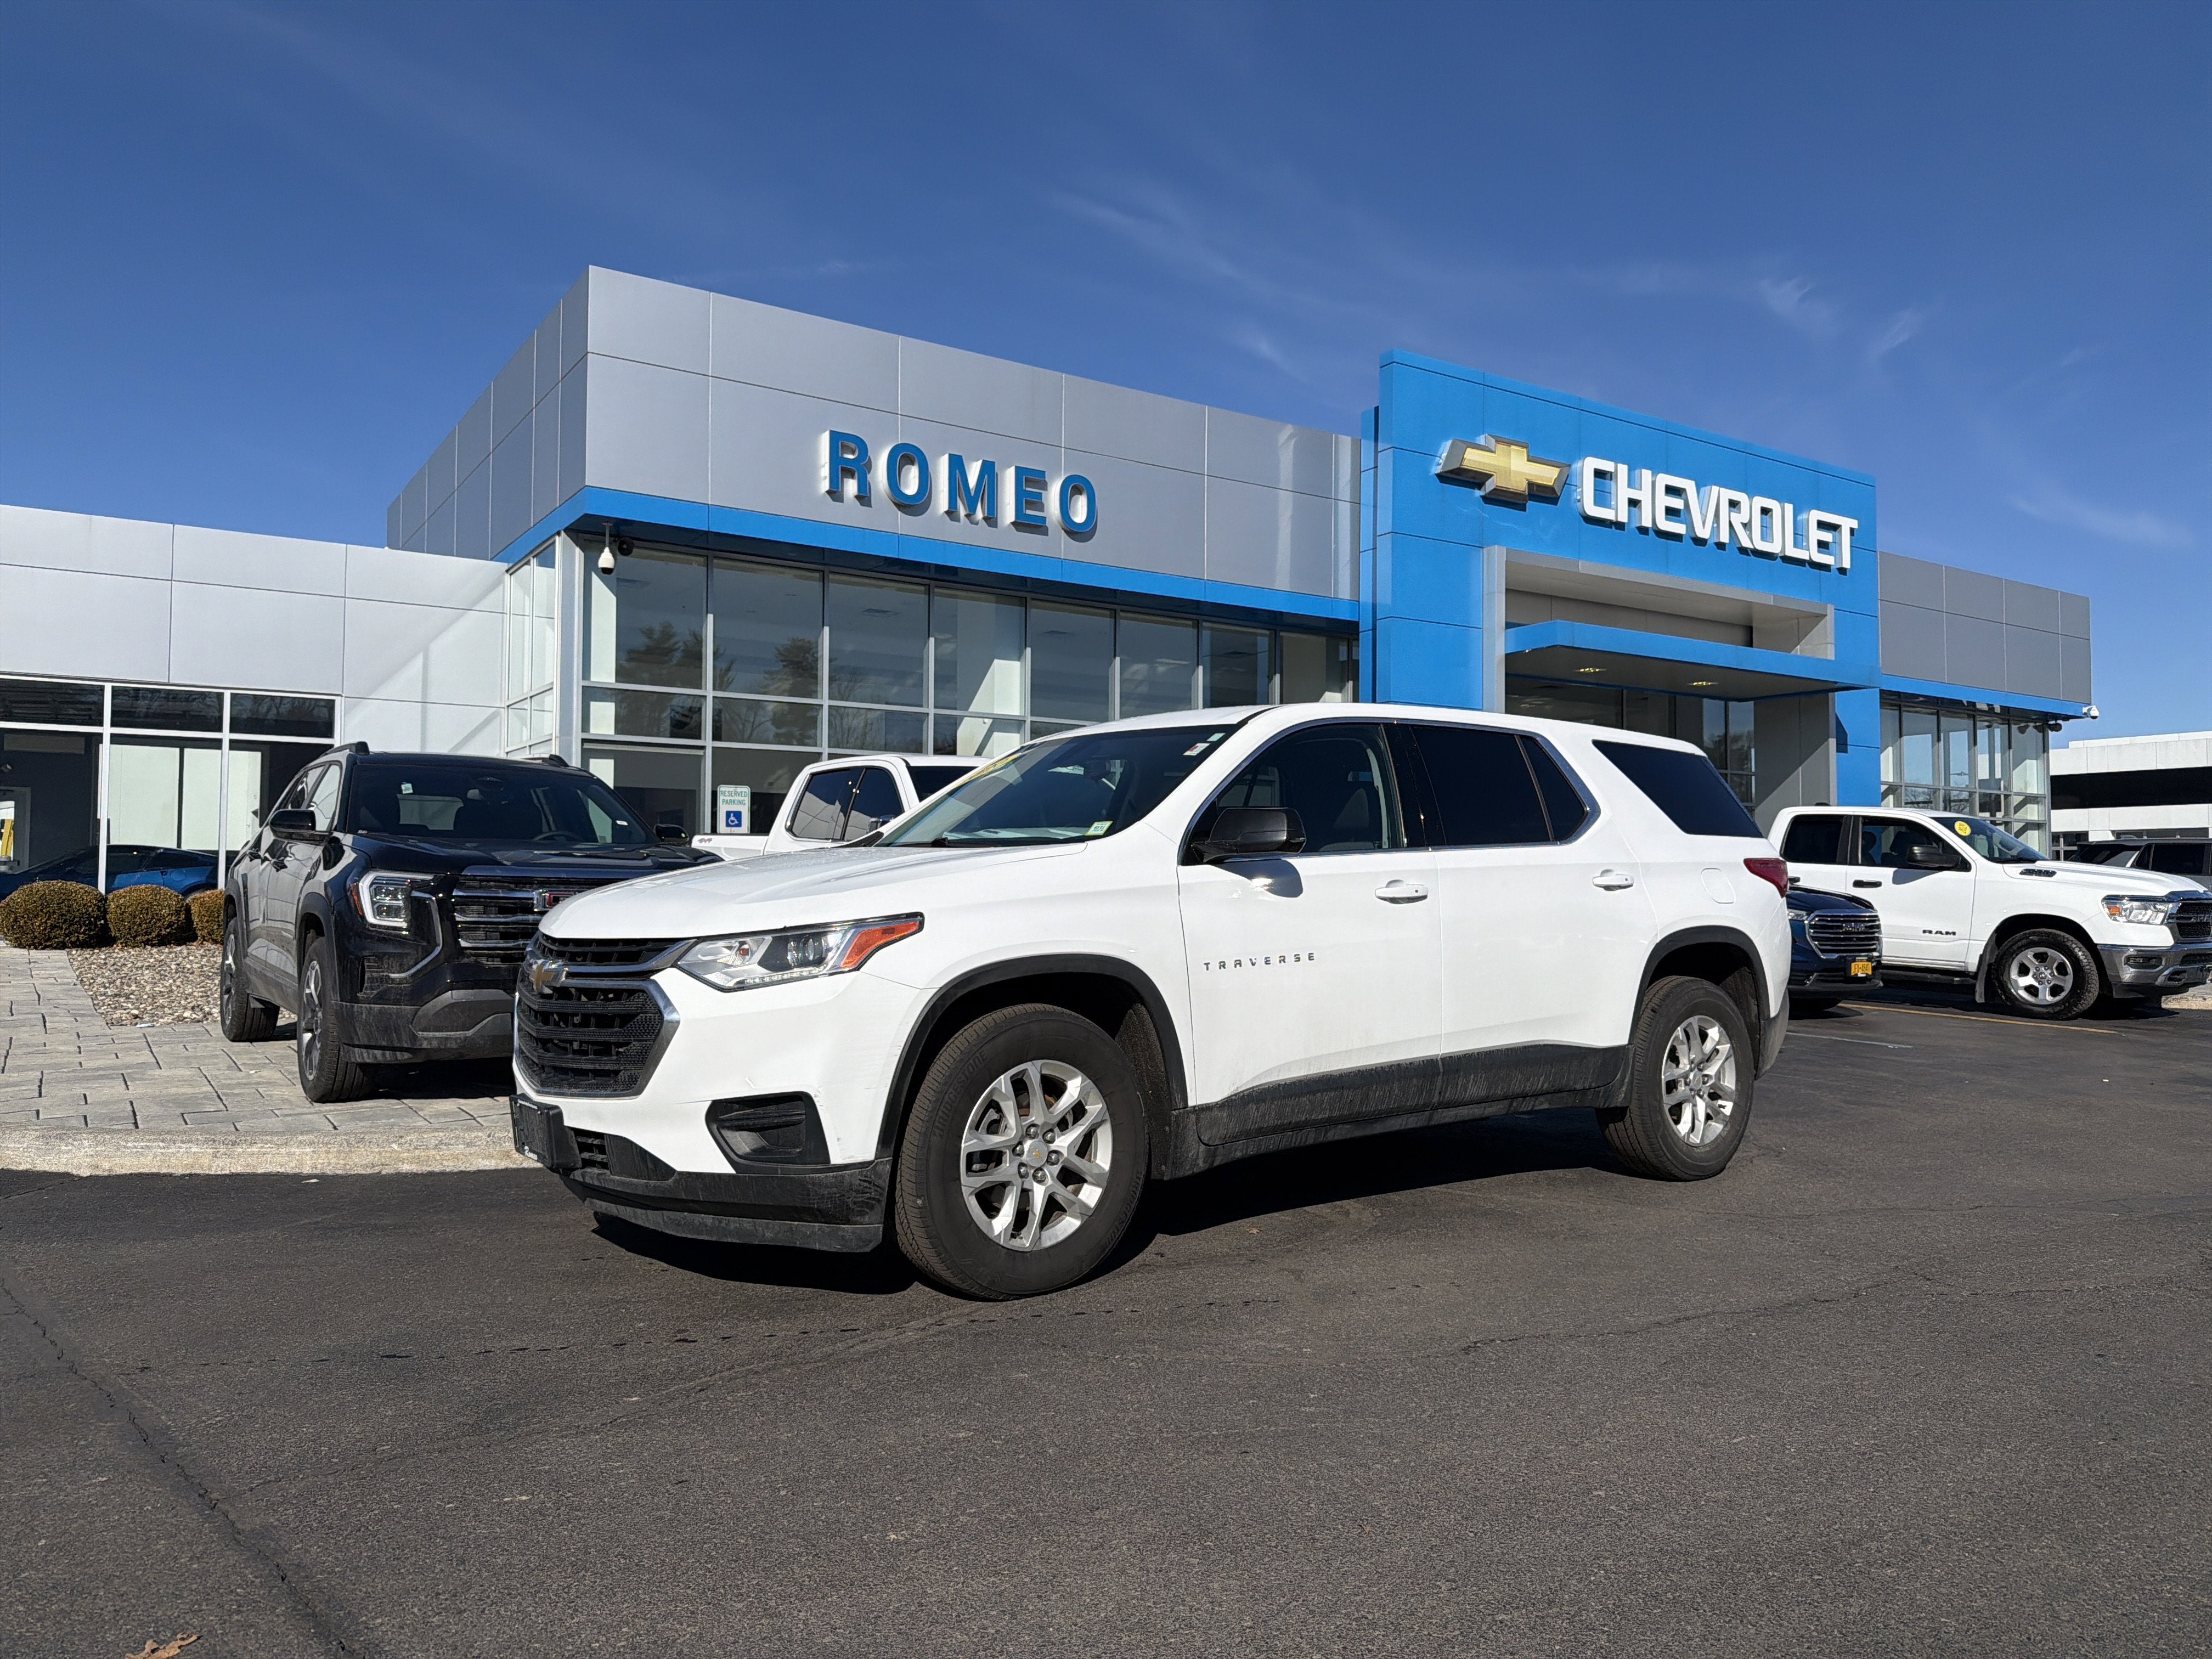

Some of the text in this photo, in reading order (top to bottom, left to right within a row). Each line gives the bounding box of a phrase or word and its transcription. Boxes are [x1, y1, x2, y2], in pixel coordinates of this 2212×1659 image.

[826, 429, 1096, 533] ROMEO
[1579, 456, 1859, 571] CHEVROLET
[1203, 952, 1314, 972] TRAVERSE
